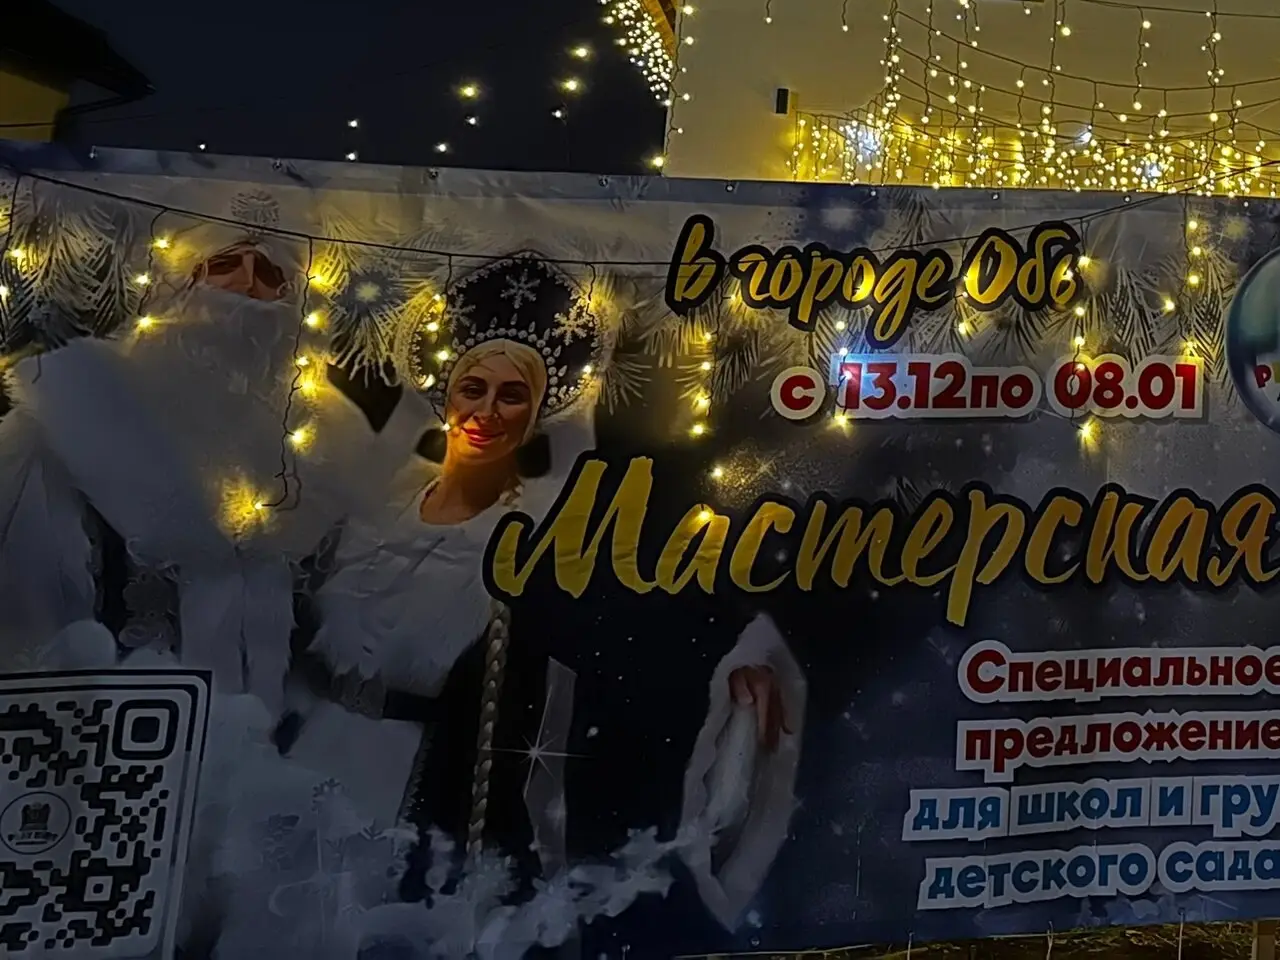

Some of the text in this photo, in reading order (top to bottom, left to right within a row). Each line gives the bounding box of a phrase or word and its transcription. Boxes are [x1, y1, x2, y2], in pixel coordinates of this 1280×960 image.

[672, 220, 718, 303] в
[733, 250, 952, 343] городе
[779, 374, 816, 411] с
[1053, 360, 1197, 411] 08.01
[911, 794, 1001, 832] для
[1016, 786, 1143, 825] школ
[1157, 784, 1184, 817] и
[927, 851, 1150, 900] детского
